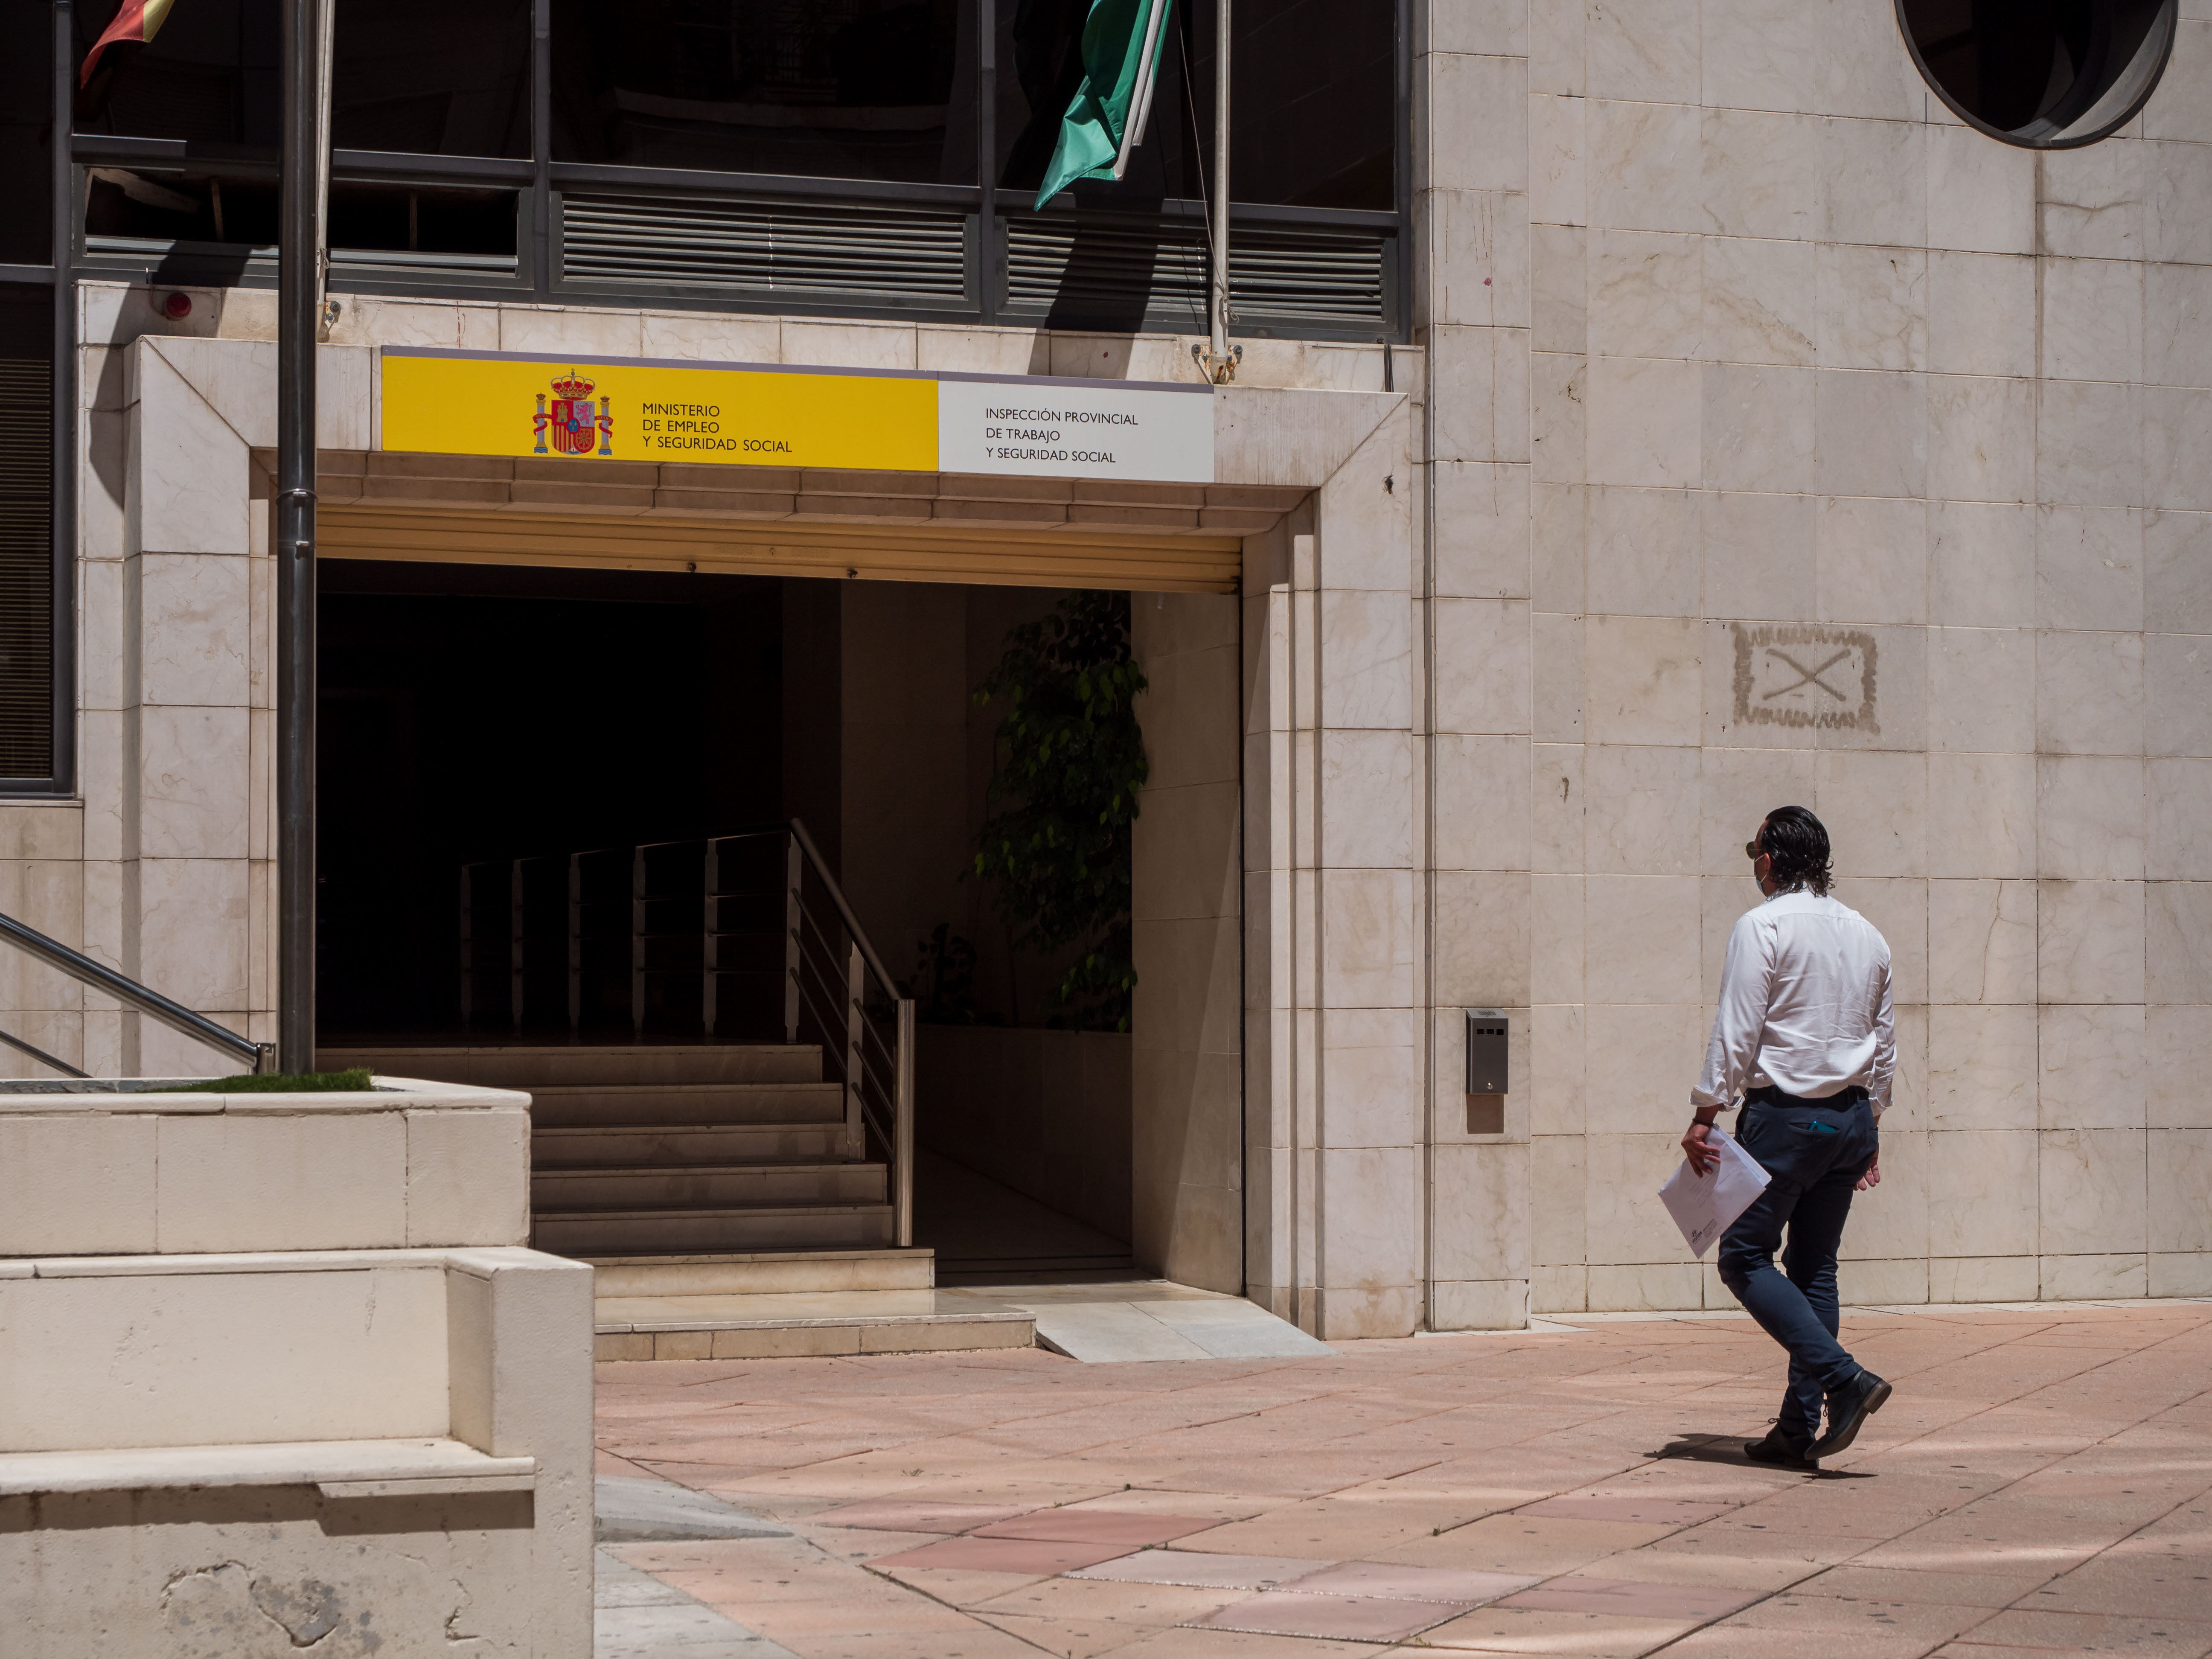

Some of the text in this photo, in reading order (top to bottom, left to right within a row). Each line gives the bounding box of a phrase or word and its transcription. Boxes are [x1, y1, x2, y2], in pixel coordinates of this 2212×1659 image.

[643, 403, 720, 416] MINISTERIO
[986, 408, 1138, 425] INSPECCIÓN PROVINCIAL
[643, 419, 719, 434] DE EMPLEO
[643, 436, 792, 452] Y SEGURIDAD SOCIAL
[986, 428, 1060, 444] DE TRABAJO
[986, 447, 1116, 463] Y SEGURIDAD SOCIAL
